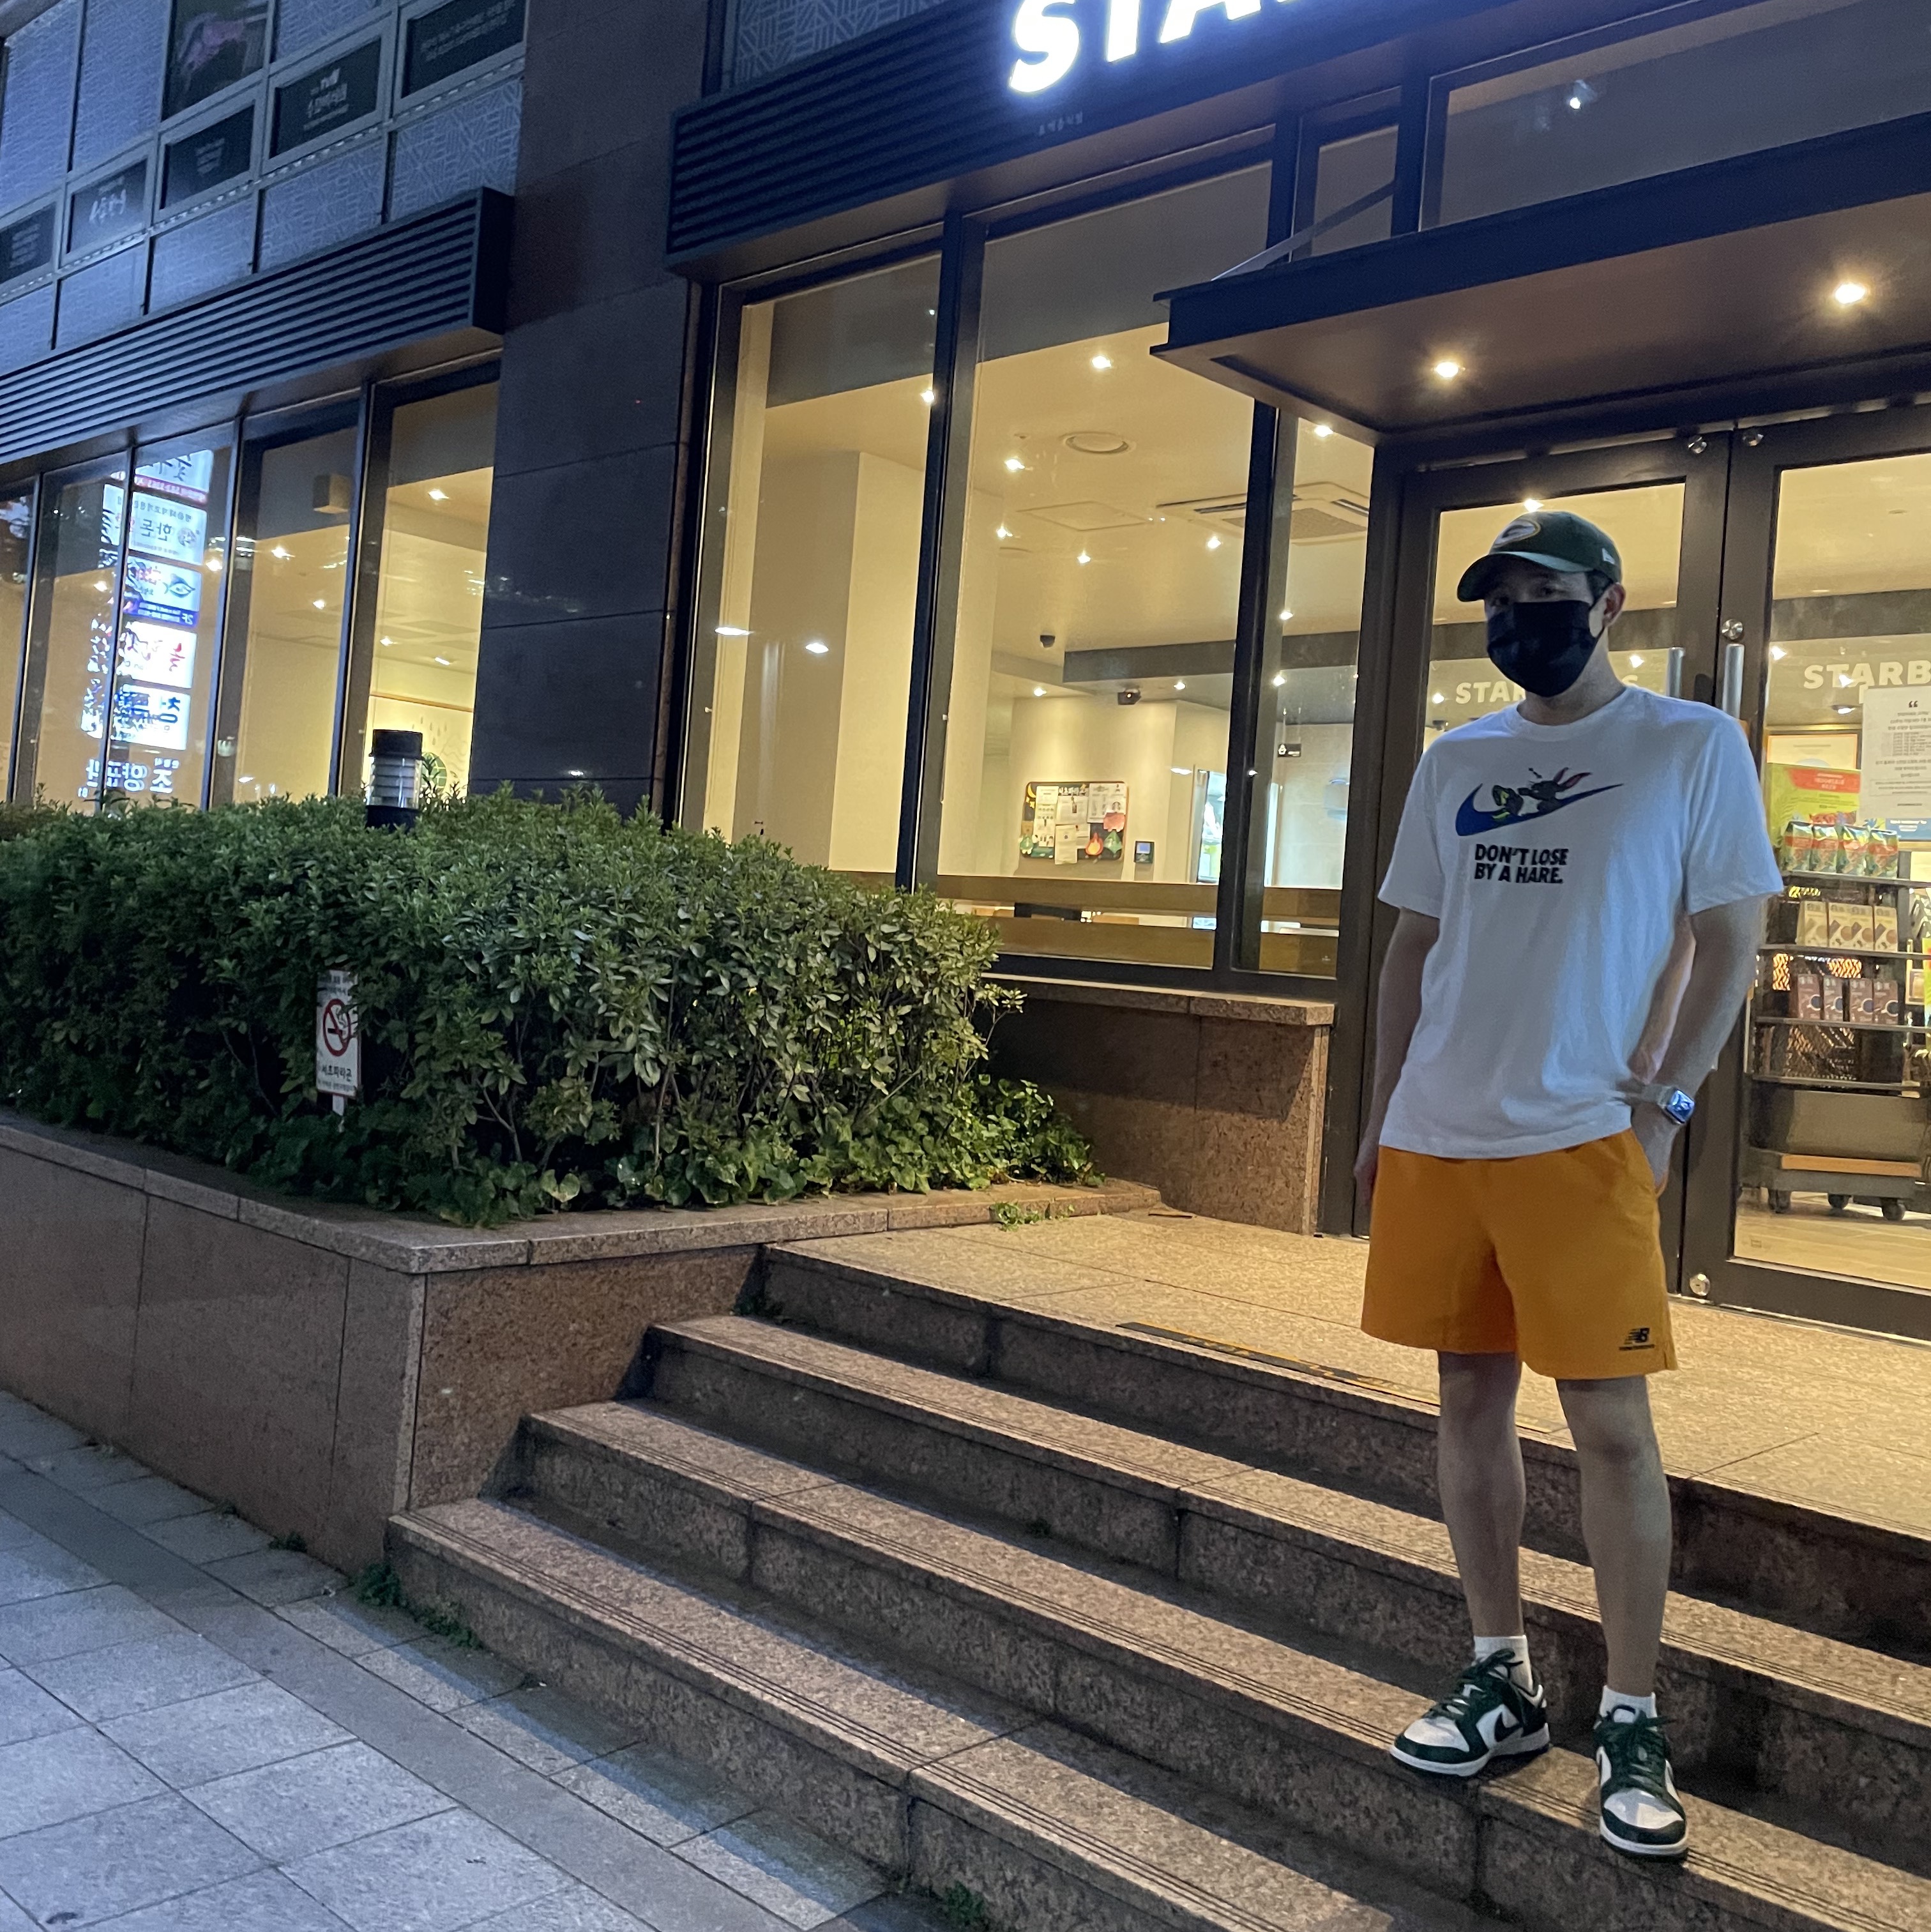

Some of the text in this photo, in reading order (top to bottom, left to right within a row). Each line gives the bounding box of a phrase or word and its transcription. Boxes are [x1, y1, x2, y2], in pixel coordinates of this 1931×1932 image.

[1475, 844, 1569, 865] DON'T LOSE
[1474, 863, 1563, 883] BY A HARE.
